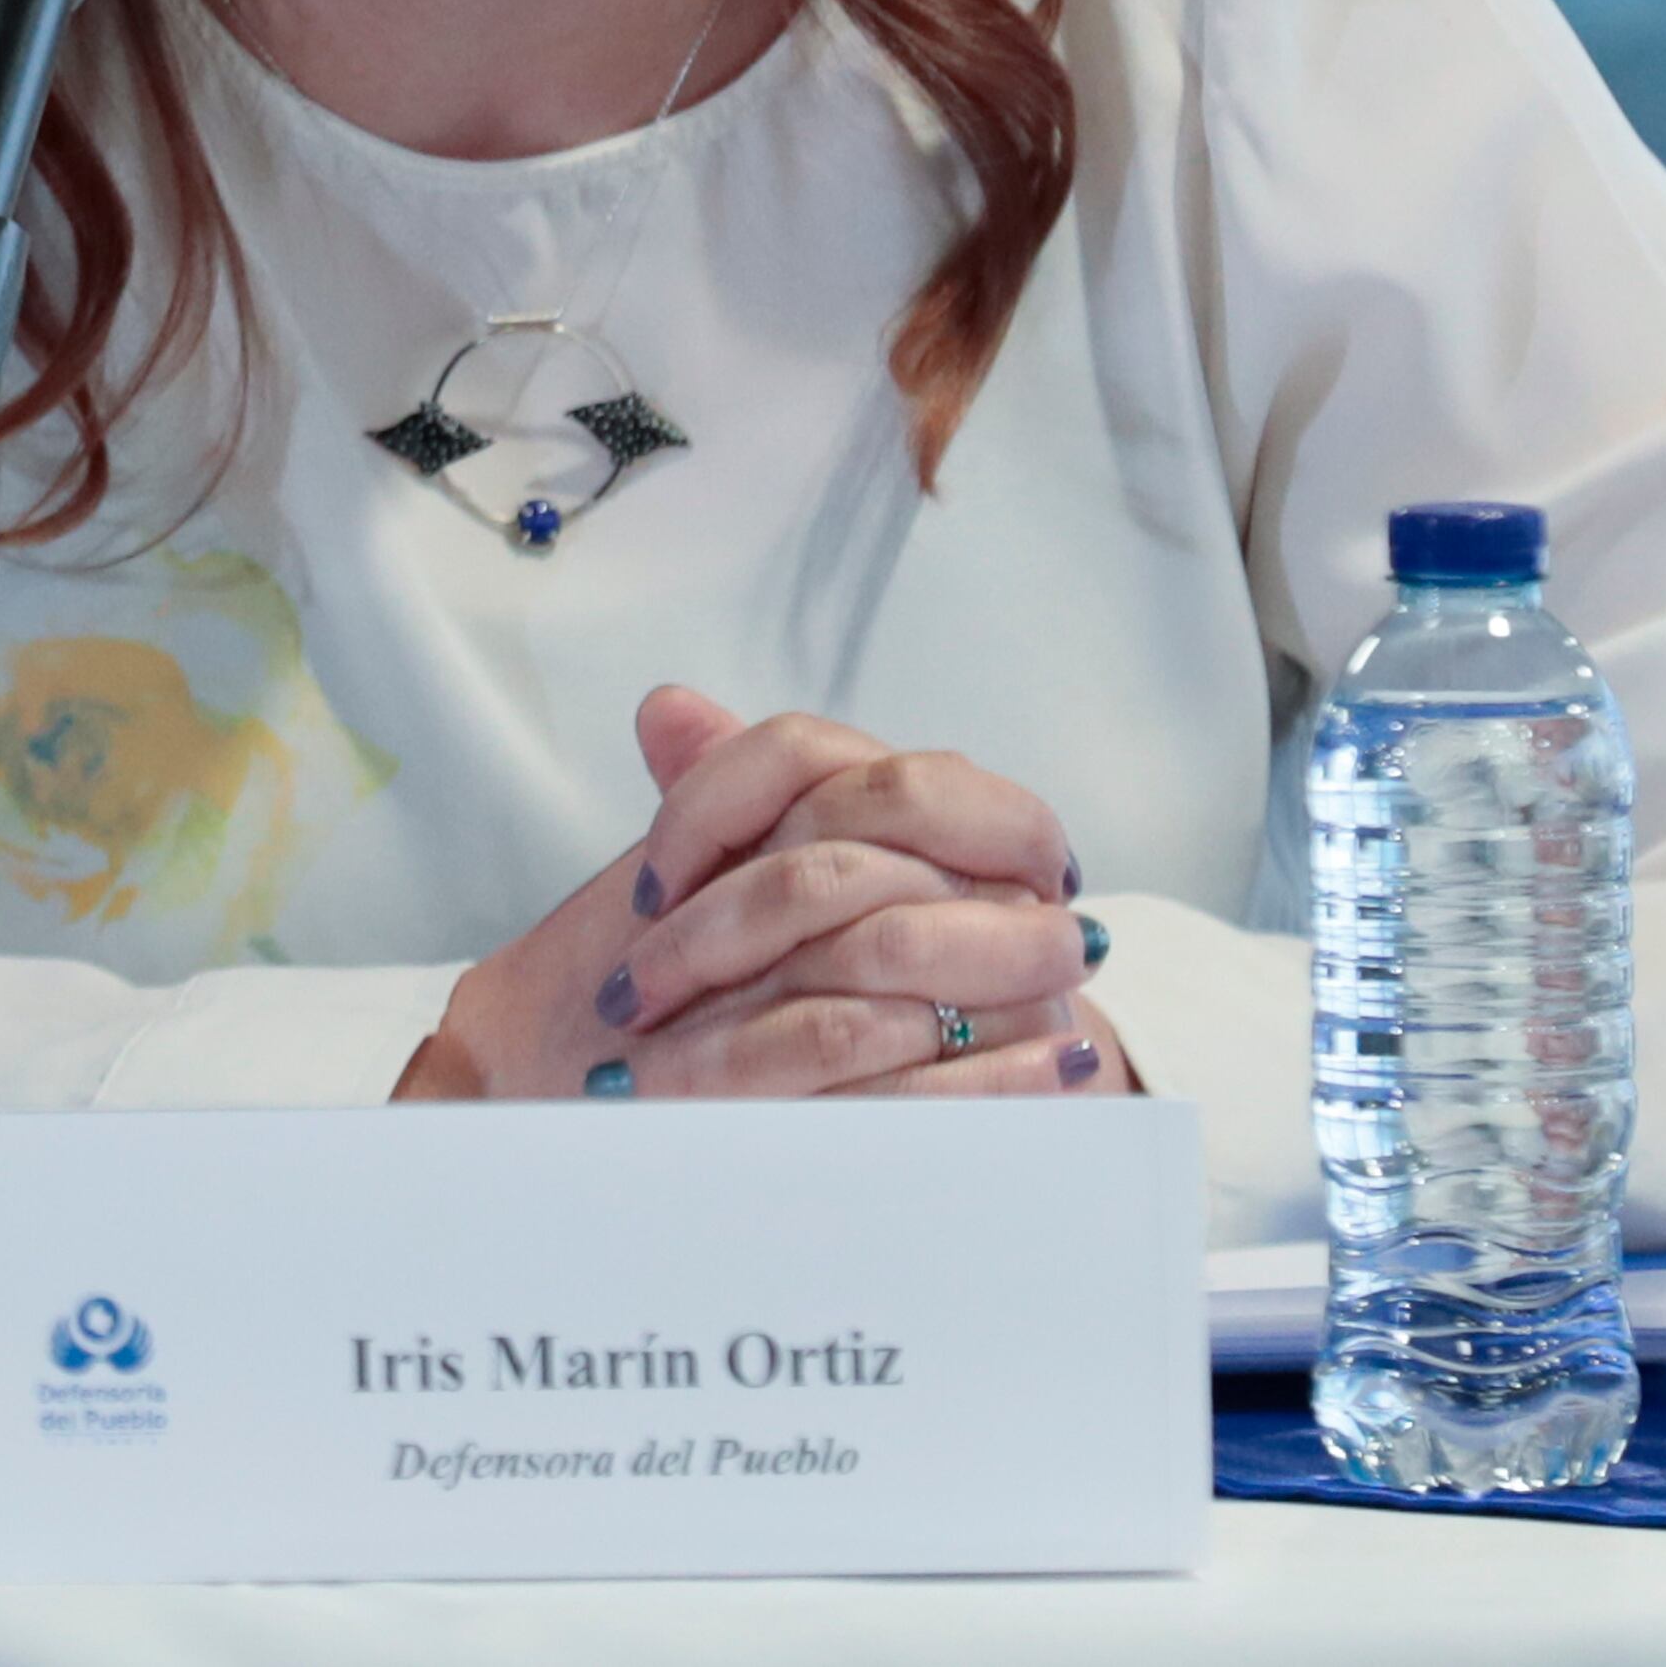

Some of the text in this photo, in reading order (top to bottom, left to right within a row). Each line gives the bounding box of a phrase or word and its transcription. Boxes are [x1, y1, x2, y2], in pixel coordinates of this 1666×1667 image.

[350, 1330, 904, 1393] Iris Marín Ortiz
[390, 1436, 860, 1491] Defensora del Pueblo
